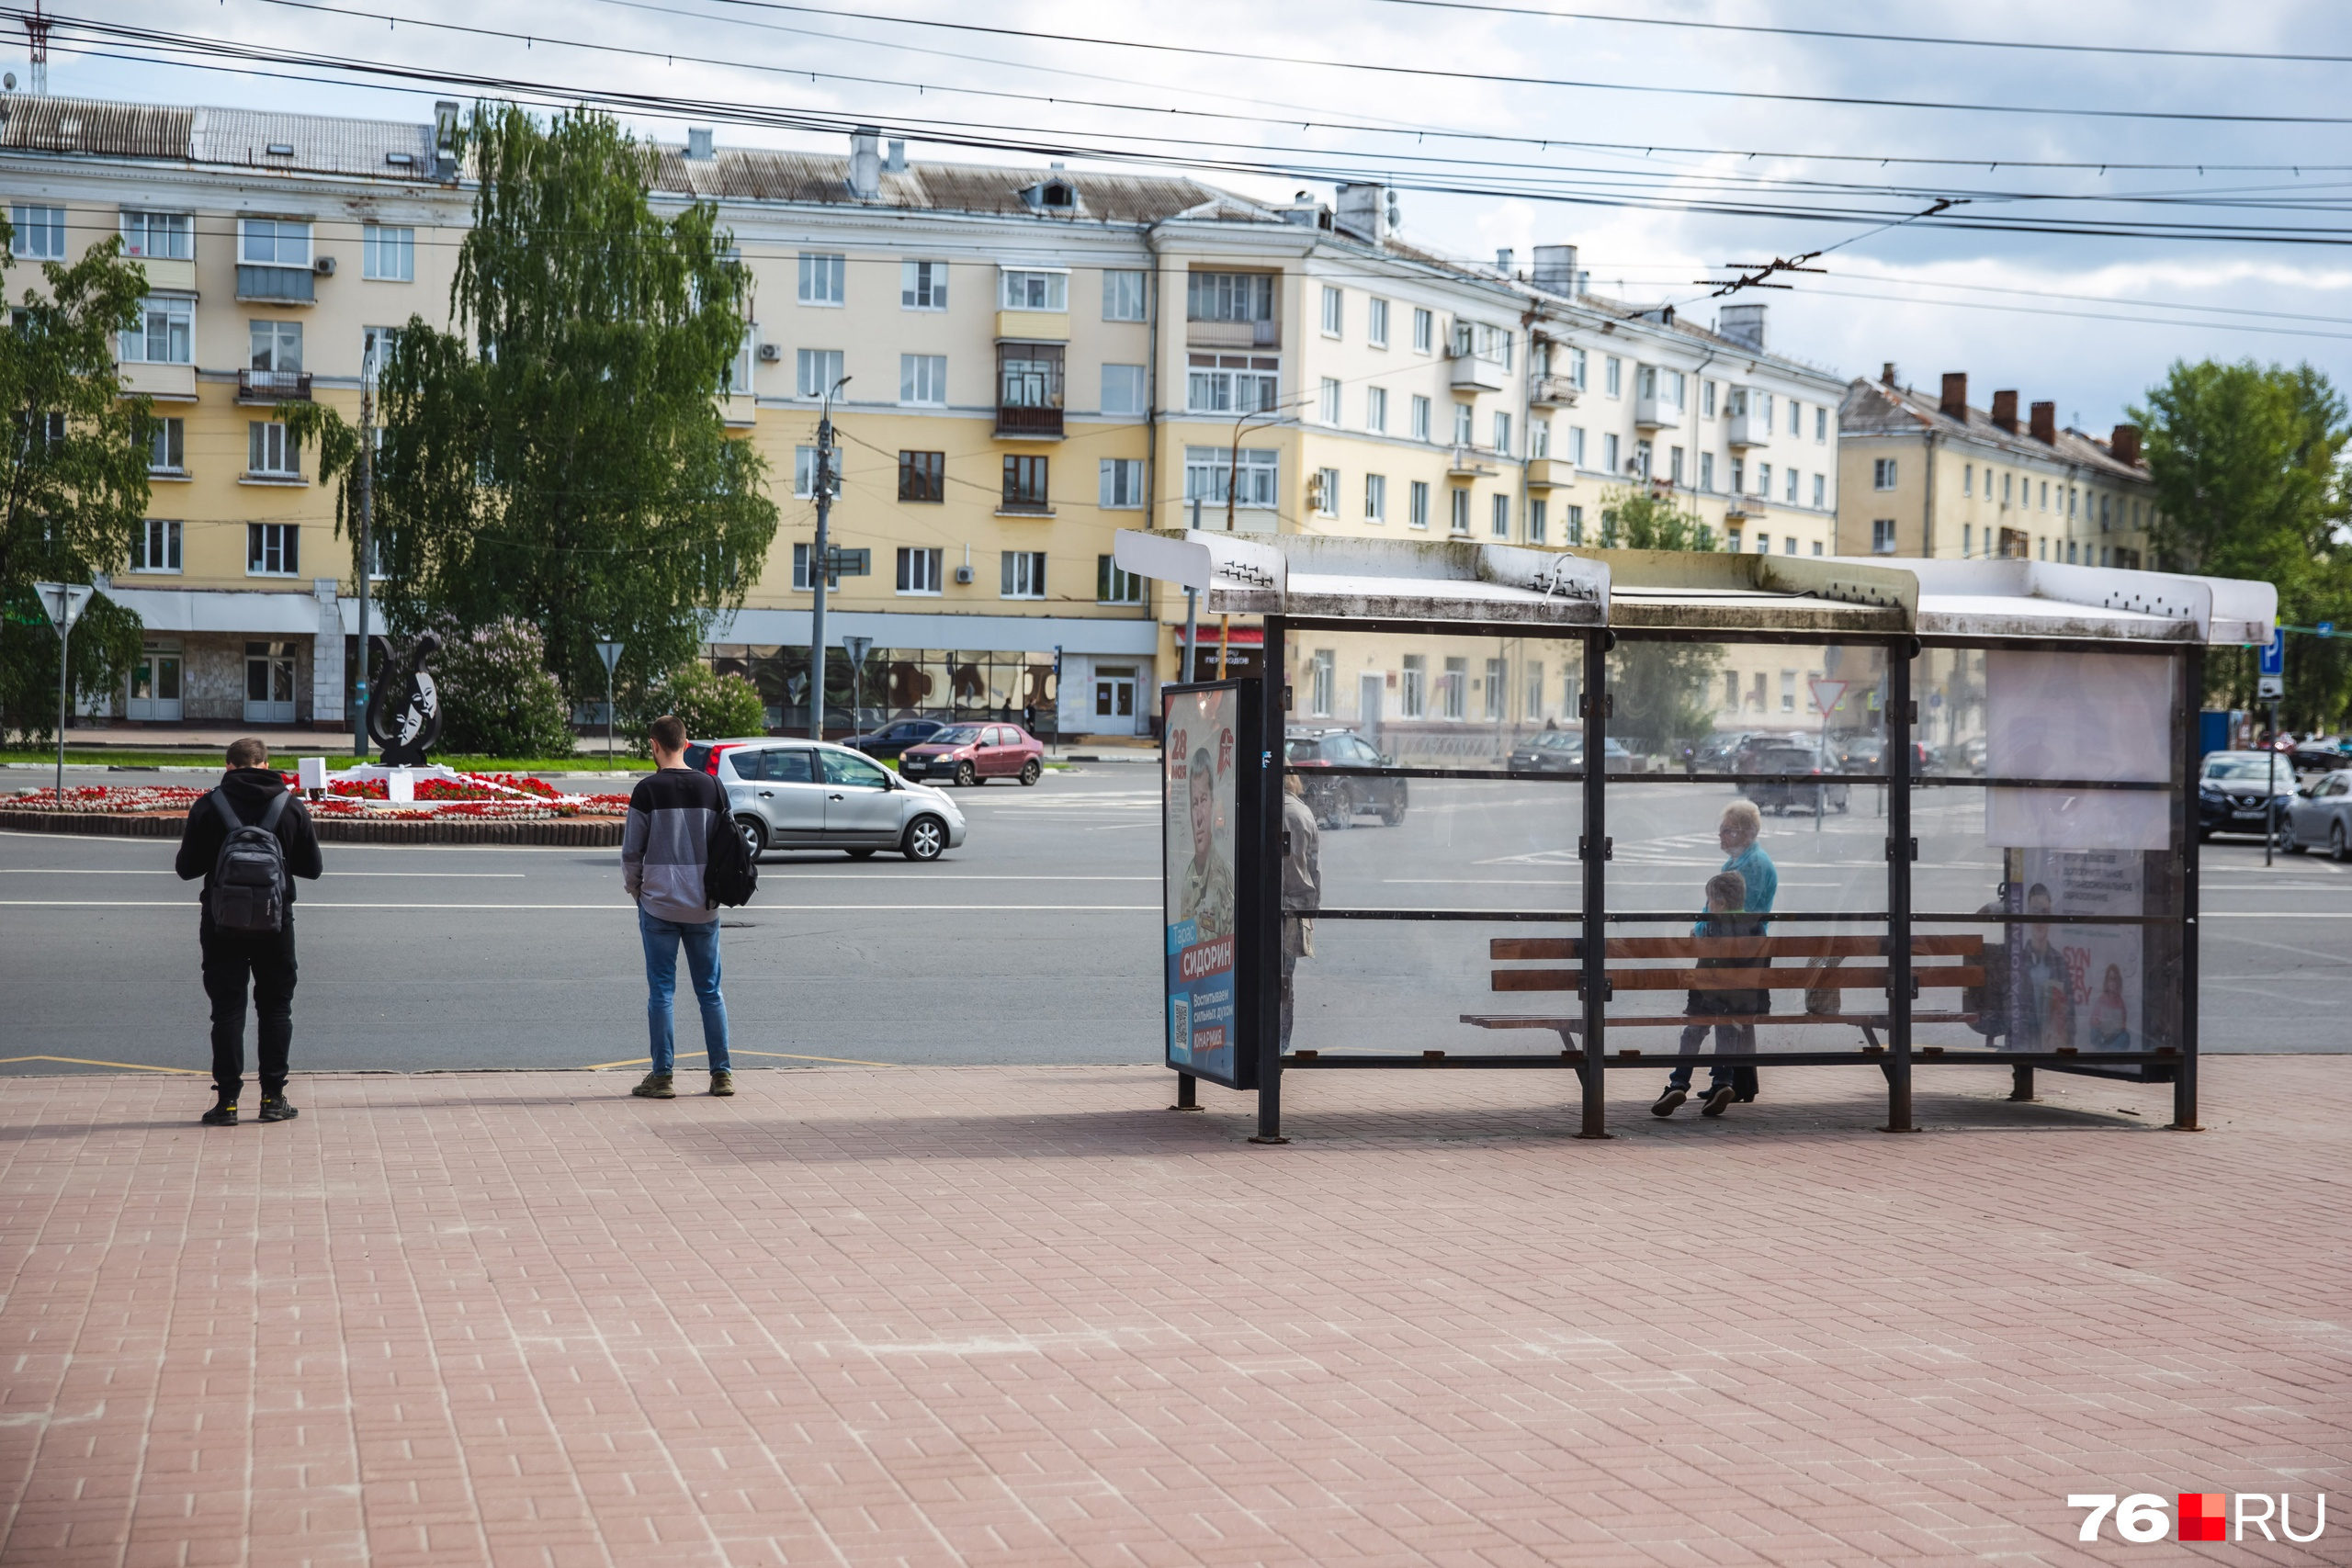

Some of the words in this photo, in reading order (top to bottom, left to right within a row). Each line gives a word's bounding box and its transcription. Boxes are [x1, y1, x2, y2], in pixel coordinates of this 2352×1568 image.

[1204, 656, 1250, 665] ПЕРВОДОВ
[1171, 728, 1187, 761] 28
[1173, 925, 1194, 949] Тарас
[1183, 941, 1231, 977] СИДОРИН
[2010, 890, 2020, 1033] ОБРАЗОВАИЕ
[1193, 988, 1229, 1008] Воспитываем
[1193, 1009, 1217, 1023] сильных
[1193, 1028, 1223, 1049] ЮНАРМИЯ
